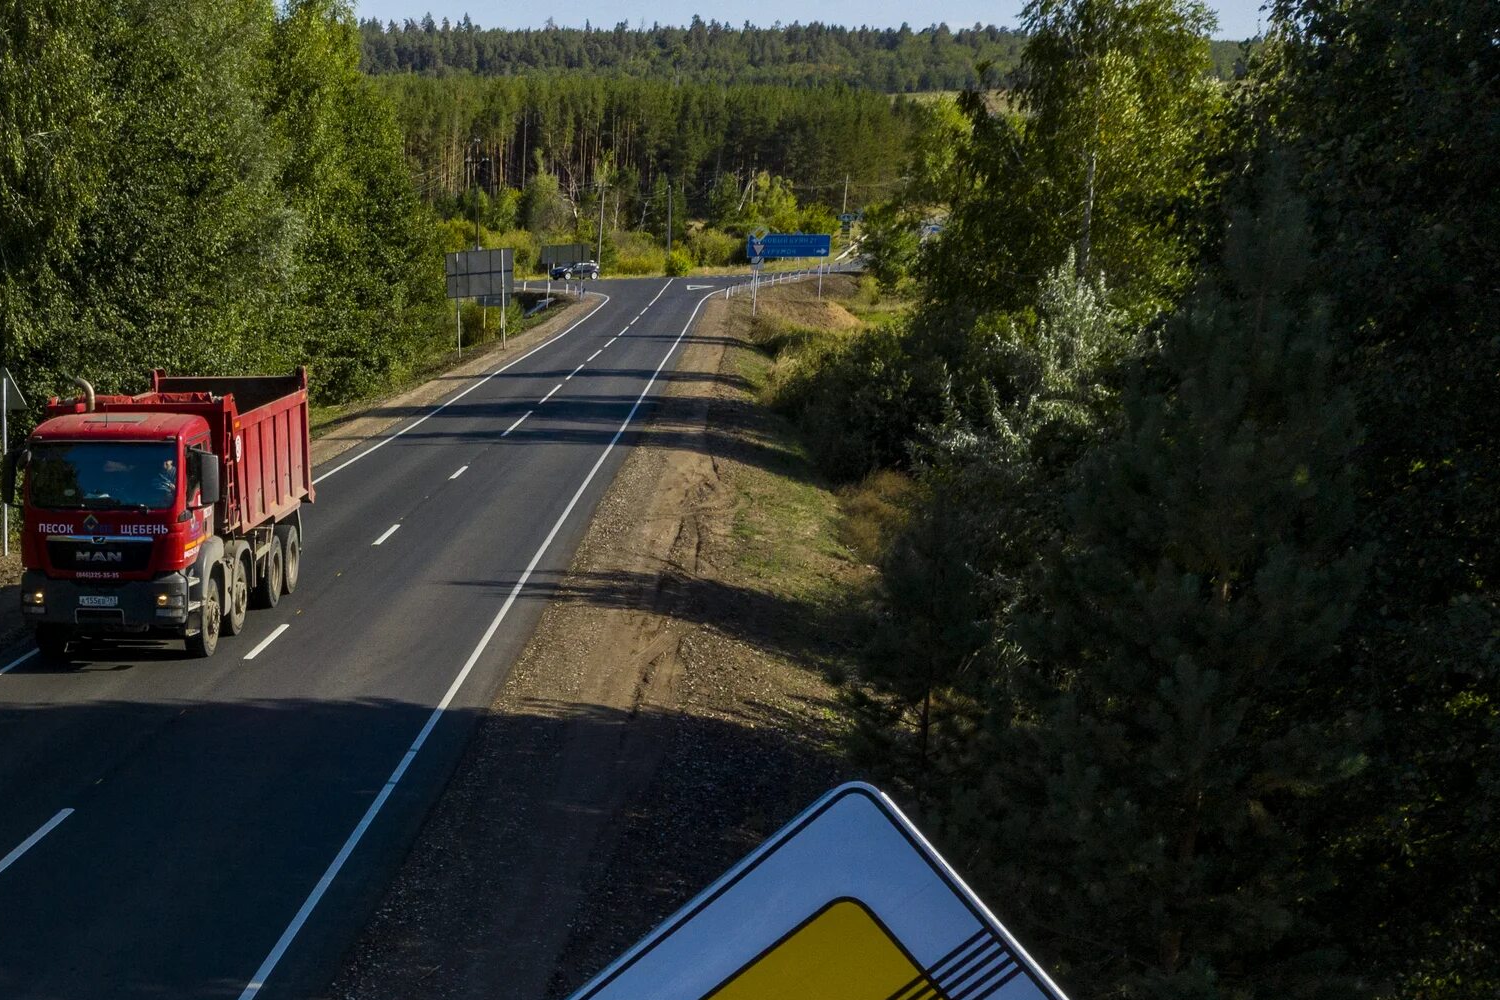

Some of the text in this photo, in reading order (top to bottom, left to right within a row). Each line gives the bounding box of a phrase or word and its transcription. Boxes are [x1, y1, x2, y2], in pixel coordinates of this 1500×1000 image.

[38, 523, 73, 534] ПЕСОК
[120, 524, 169, 536] ЩЕБЕНЬ
[75, 551, 122, 562] MAN
